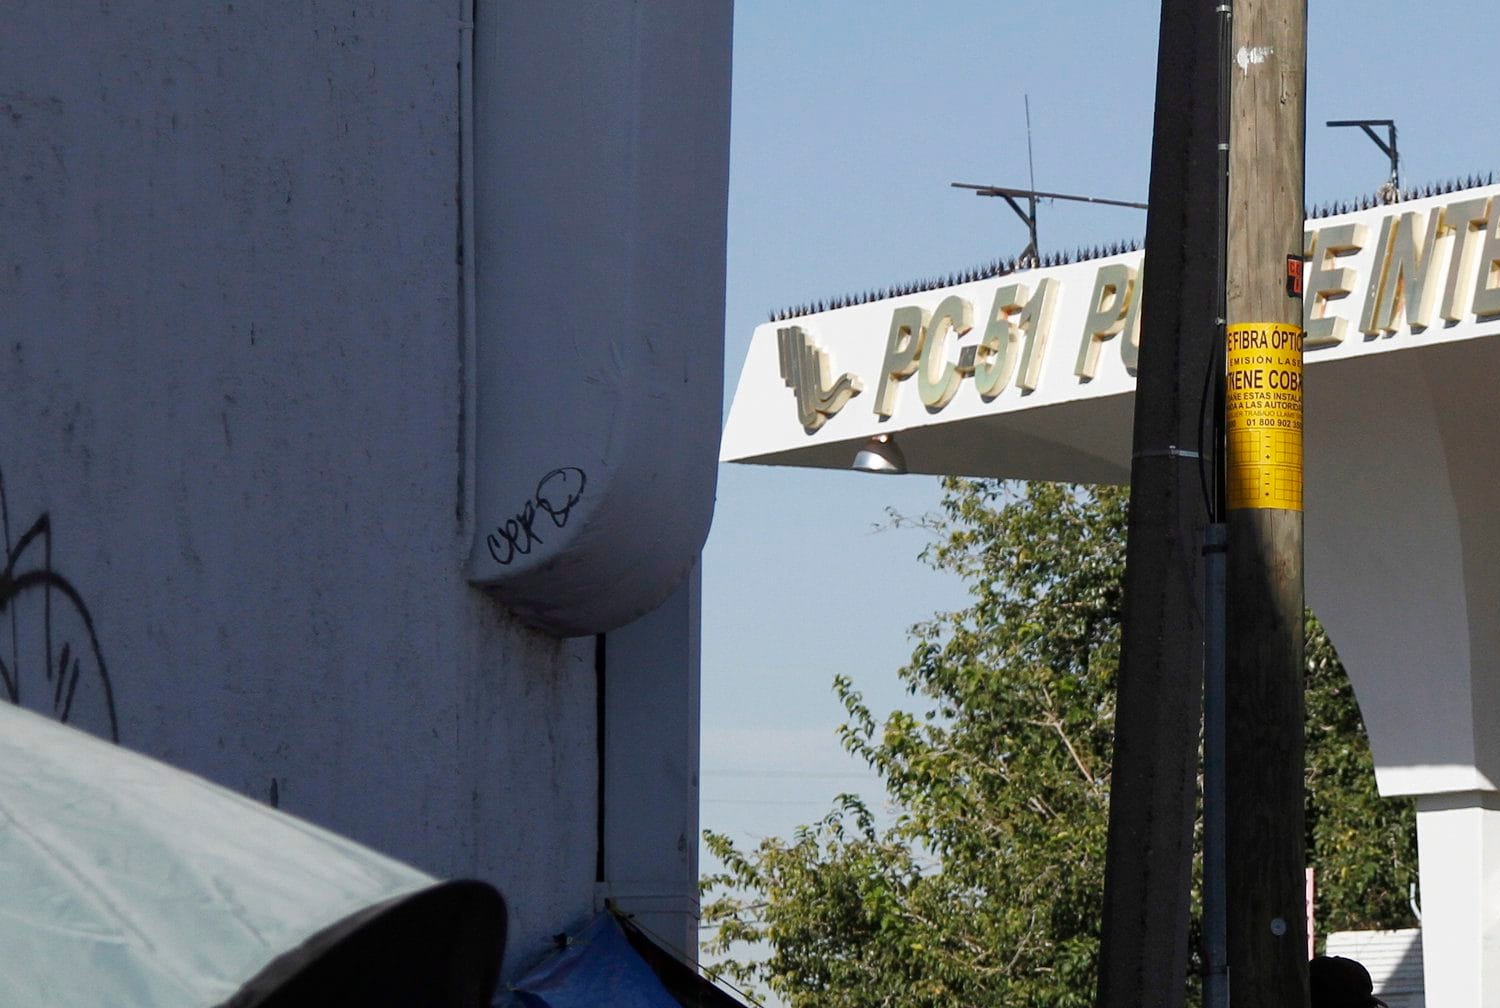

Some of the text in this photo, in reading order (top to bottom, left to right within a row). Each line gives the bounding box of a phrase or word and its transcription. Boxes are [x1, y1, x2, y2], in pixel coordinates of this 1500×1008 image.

[1233, 330, 1268, 350] FIBRA
[1272, 325, 1302, 352] ÓPTIC
[872, 277, 1061, 421] PC-51
[1277, 357, 1301, 368] LASE
[1243, 391, 1271, 400] ESTAS
[1245, 400, 1262, 409] LAS
[1246, 418, 1256, 426] 01
[1259, 418, 1275, 427] 800
[1277, 418, 1291, 428] 902
